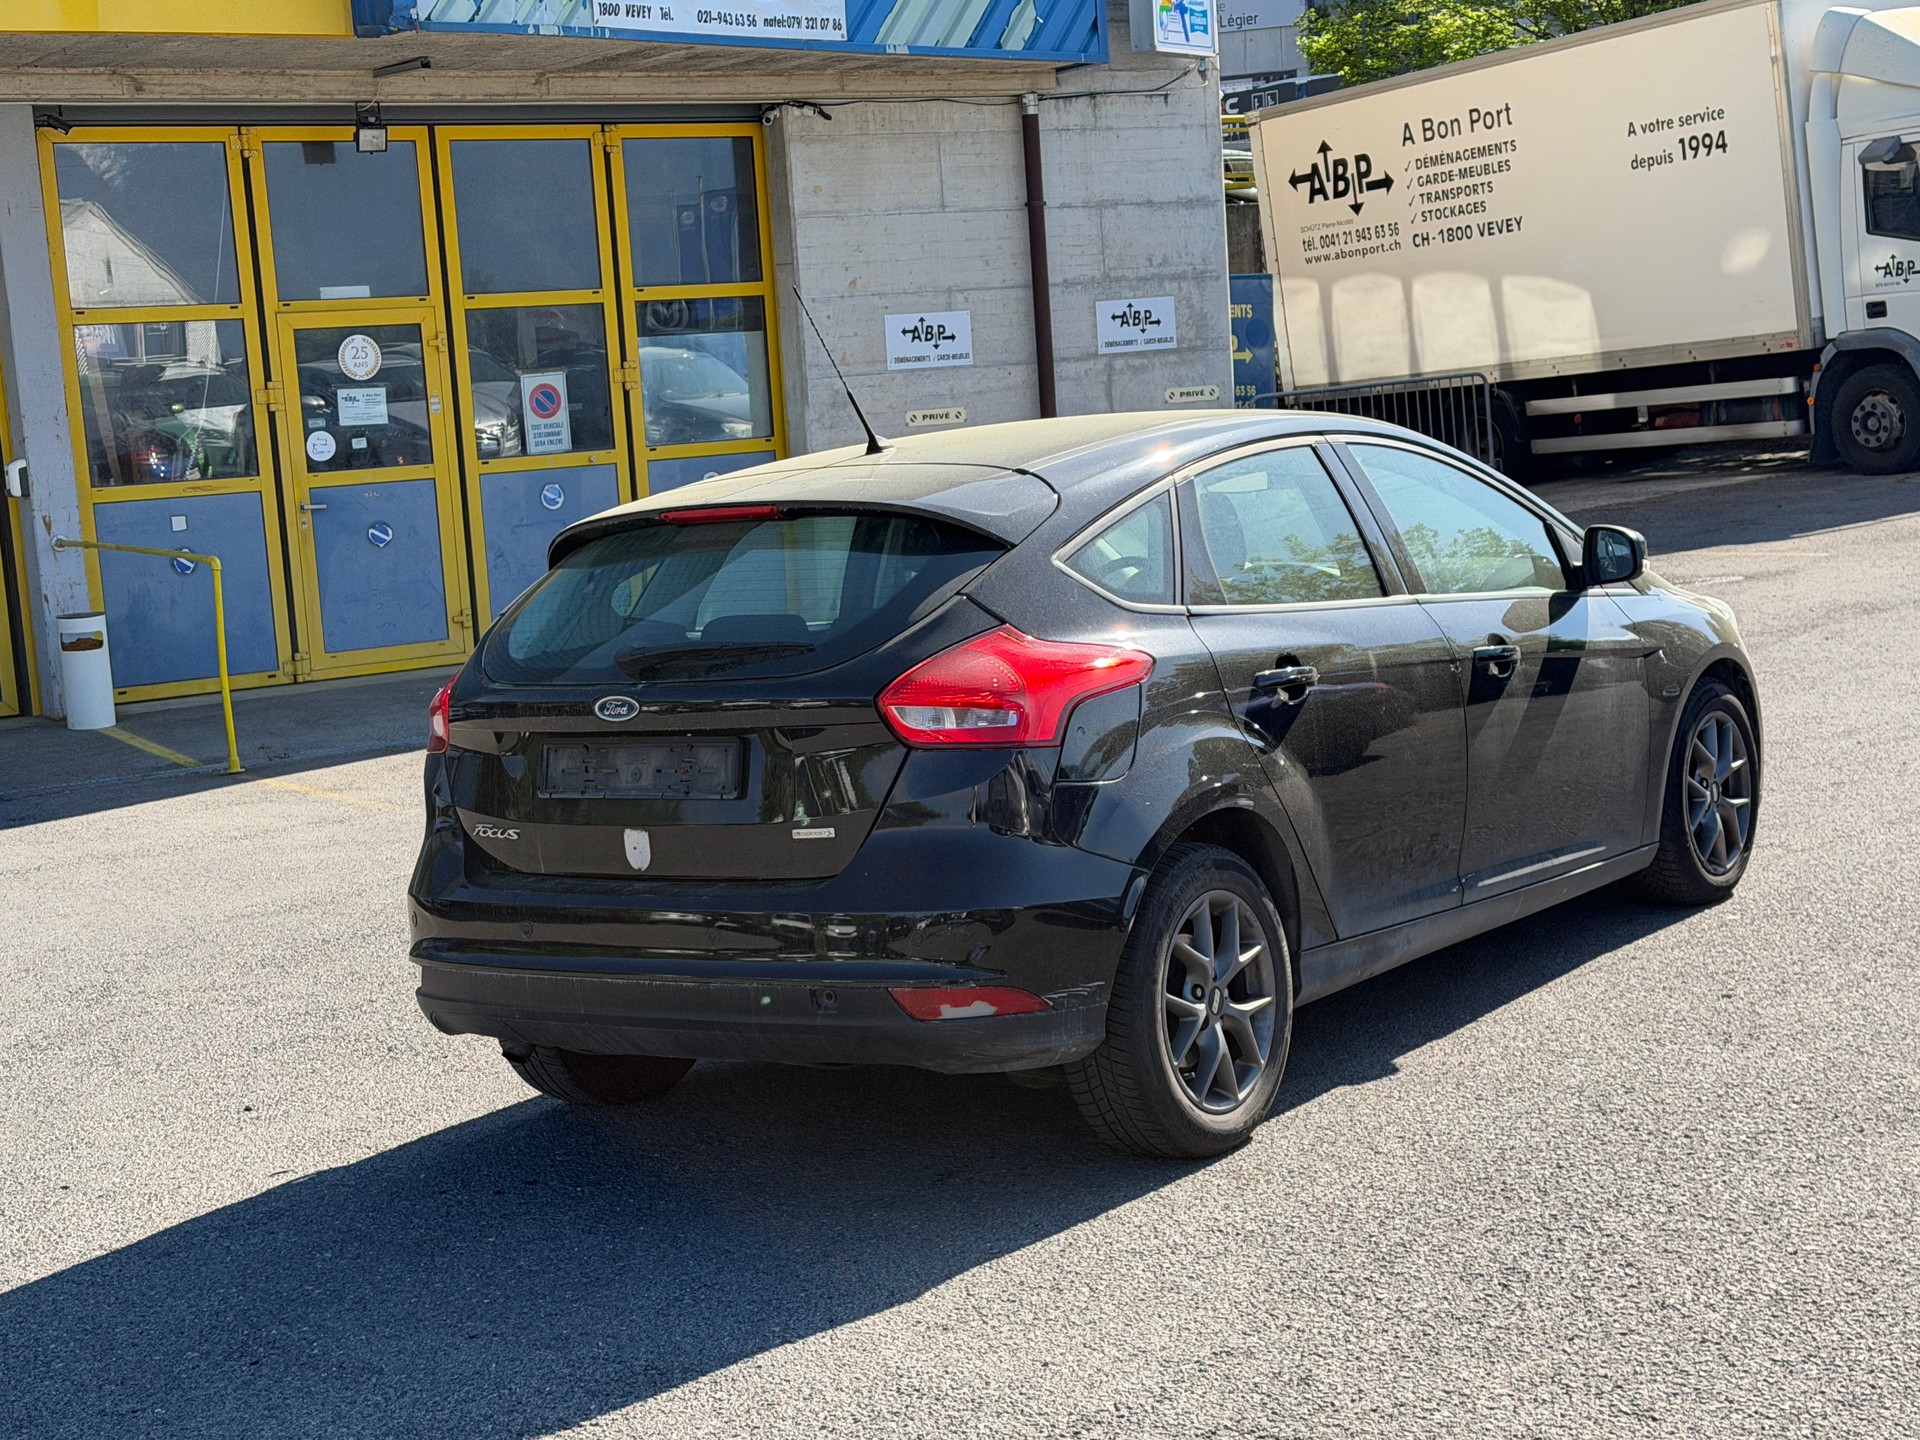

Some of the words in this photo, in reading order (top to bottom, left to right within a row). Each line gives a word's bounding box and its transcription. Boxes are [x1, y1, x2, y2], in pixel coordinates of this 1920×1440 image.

[598, 2, 620, 17] 1800
[625, 3, 652, 20] VEVEY
[659, 6, 675, 21] Tél.
[735, 13, 746, 27] 63
[747, 14, 758, 28] 56
[805, 16, 818, 30] 321
[820, 17, 830, 31] 07
[832, 17, 843, 32] 86
[1402, 122, 1416, 147] A
[1421, 117, 1462, 143] Bon
[1468, 102, 1513, 133] Port
[1627, 121, 1638, 137] A
[1640, 117, 1675, 135] votre
[1678, 106, 1725, 128] service
[1415, 139, 1517, 171] DÉMÉNAGEMENTS
[1630, 149, 1674, 171] depuis
[1678, 130, 1728, 161] 1994
[1308, 153, 1373, 205] ABP
[1417, 159, 1511, 188] GARDE-MEUBLES
[1419, 181, 1494, 205] TRANSPORTS
[1421, 200, 1487, 223] STOCKAGES
[1302, 236, 1318, 252] tél.
[1319, 231, 1341, 249] 0041
[1342, 230, 1353, 245] 21
[1355, 226, 1372, 242] 943
[1374, 224, 1386, 239] 63
[1387, 222, 1400, 236] 56
[1476, 216, 1523, 238] VEVEY
[1304, 239, 1402, 265] www.abonport.ch
[351, 346, 369, 360] 25
[1180, 388, 1206, 398] PRIVÉ
[922, 411, 951, 421] PRIVÉ
[604, 700, 628, 715] Ford
